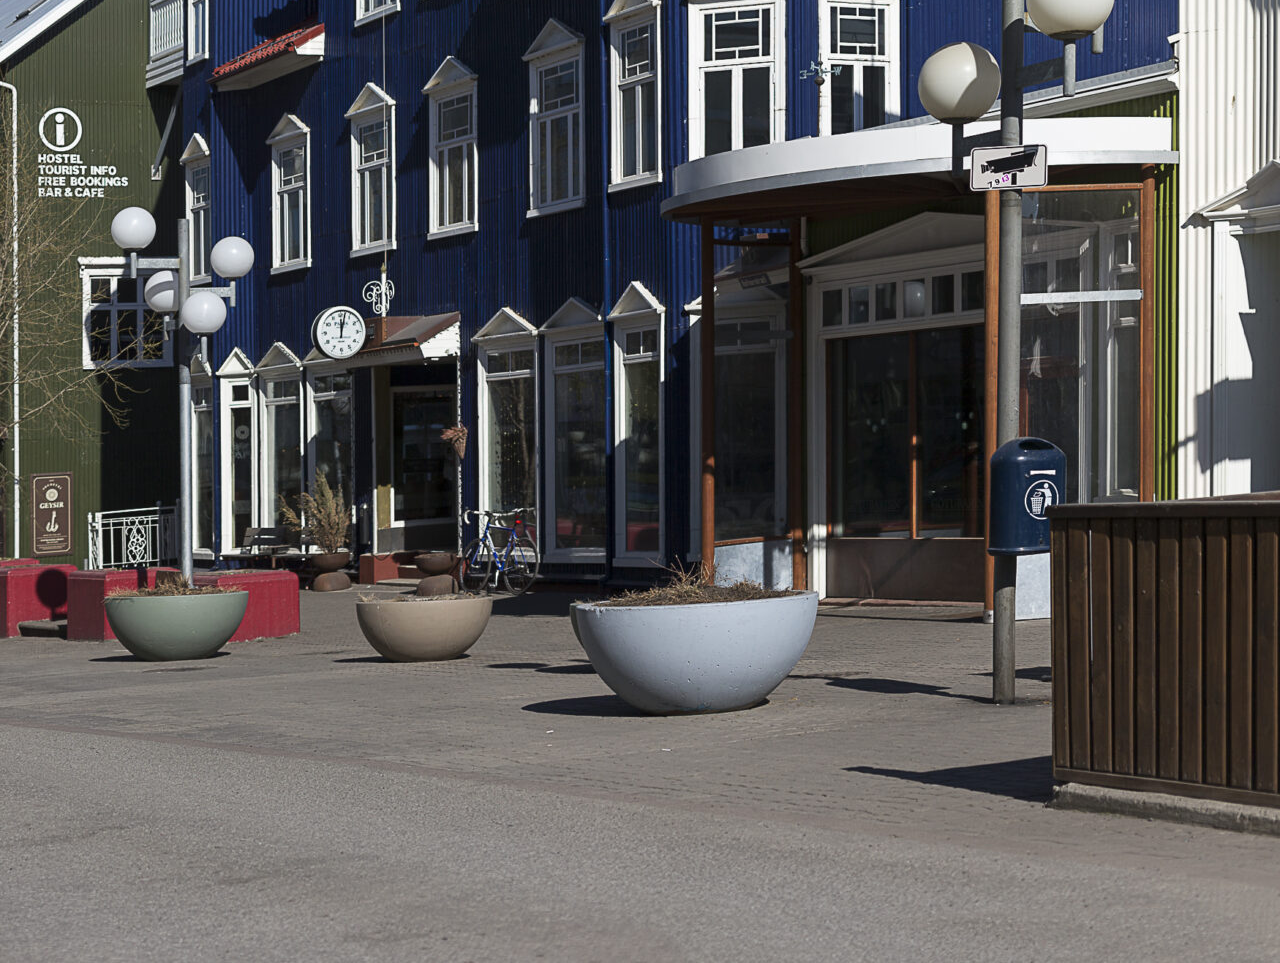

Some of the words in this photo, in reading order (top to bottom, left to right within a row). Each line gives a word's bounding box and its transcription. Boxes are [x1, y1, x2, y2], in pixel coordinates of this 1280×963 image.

[38, 154, 83, 164] HOSTEL
[38, 165, 88, 175] TOURIST
[90, 166, 116, 176] INFO
[38, 176, 66, 186] FREE
[70, 176, 128, 186] BOOKINGS
[38, 188, 62, 197] BAR
[64, 188, 72, 197] &
[74, 188, 104, 198] CAFE
